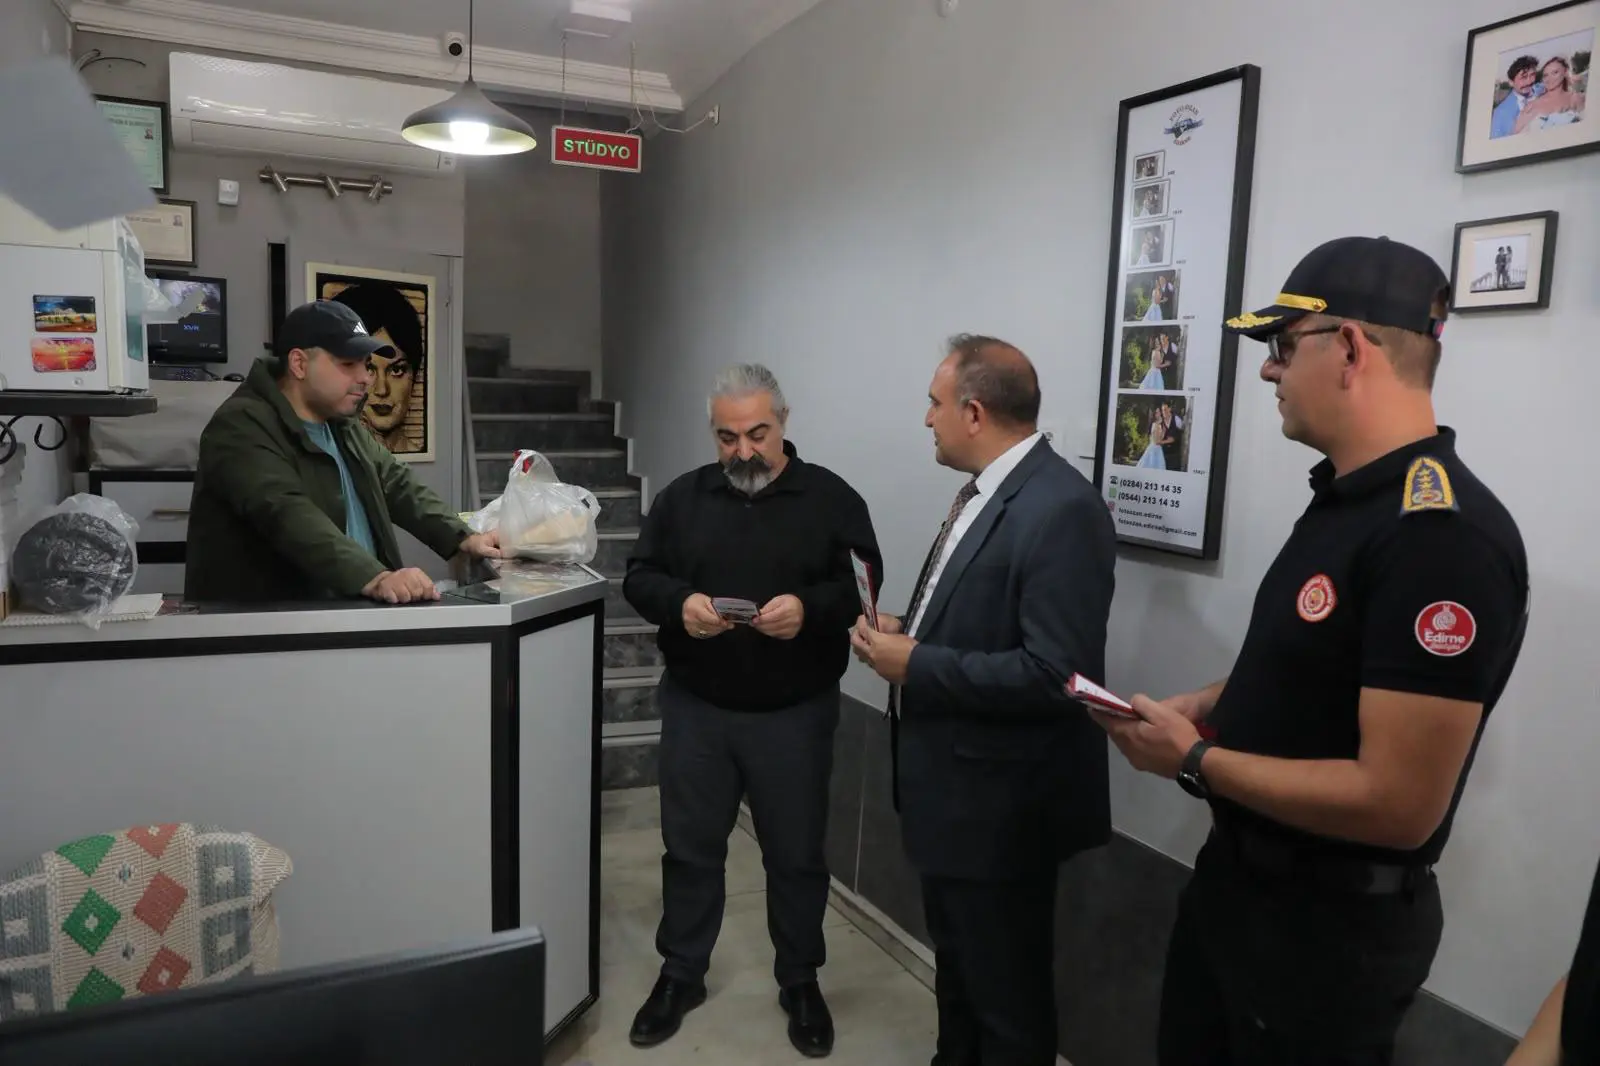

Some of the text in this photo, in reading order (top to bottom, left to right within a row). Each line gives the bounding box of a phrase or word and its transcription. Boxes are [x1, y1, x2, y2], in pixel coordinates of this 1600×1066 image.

[563, 138, 631, 160] STÜDYO
[1119, 479, 1182, 494] (0284) 213 14 35
[1118, 491, 1180, 509] (0544) 213 14 35
[1424, 631, 1465, 644] Edirne
